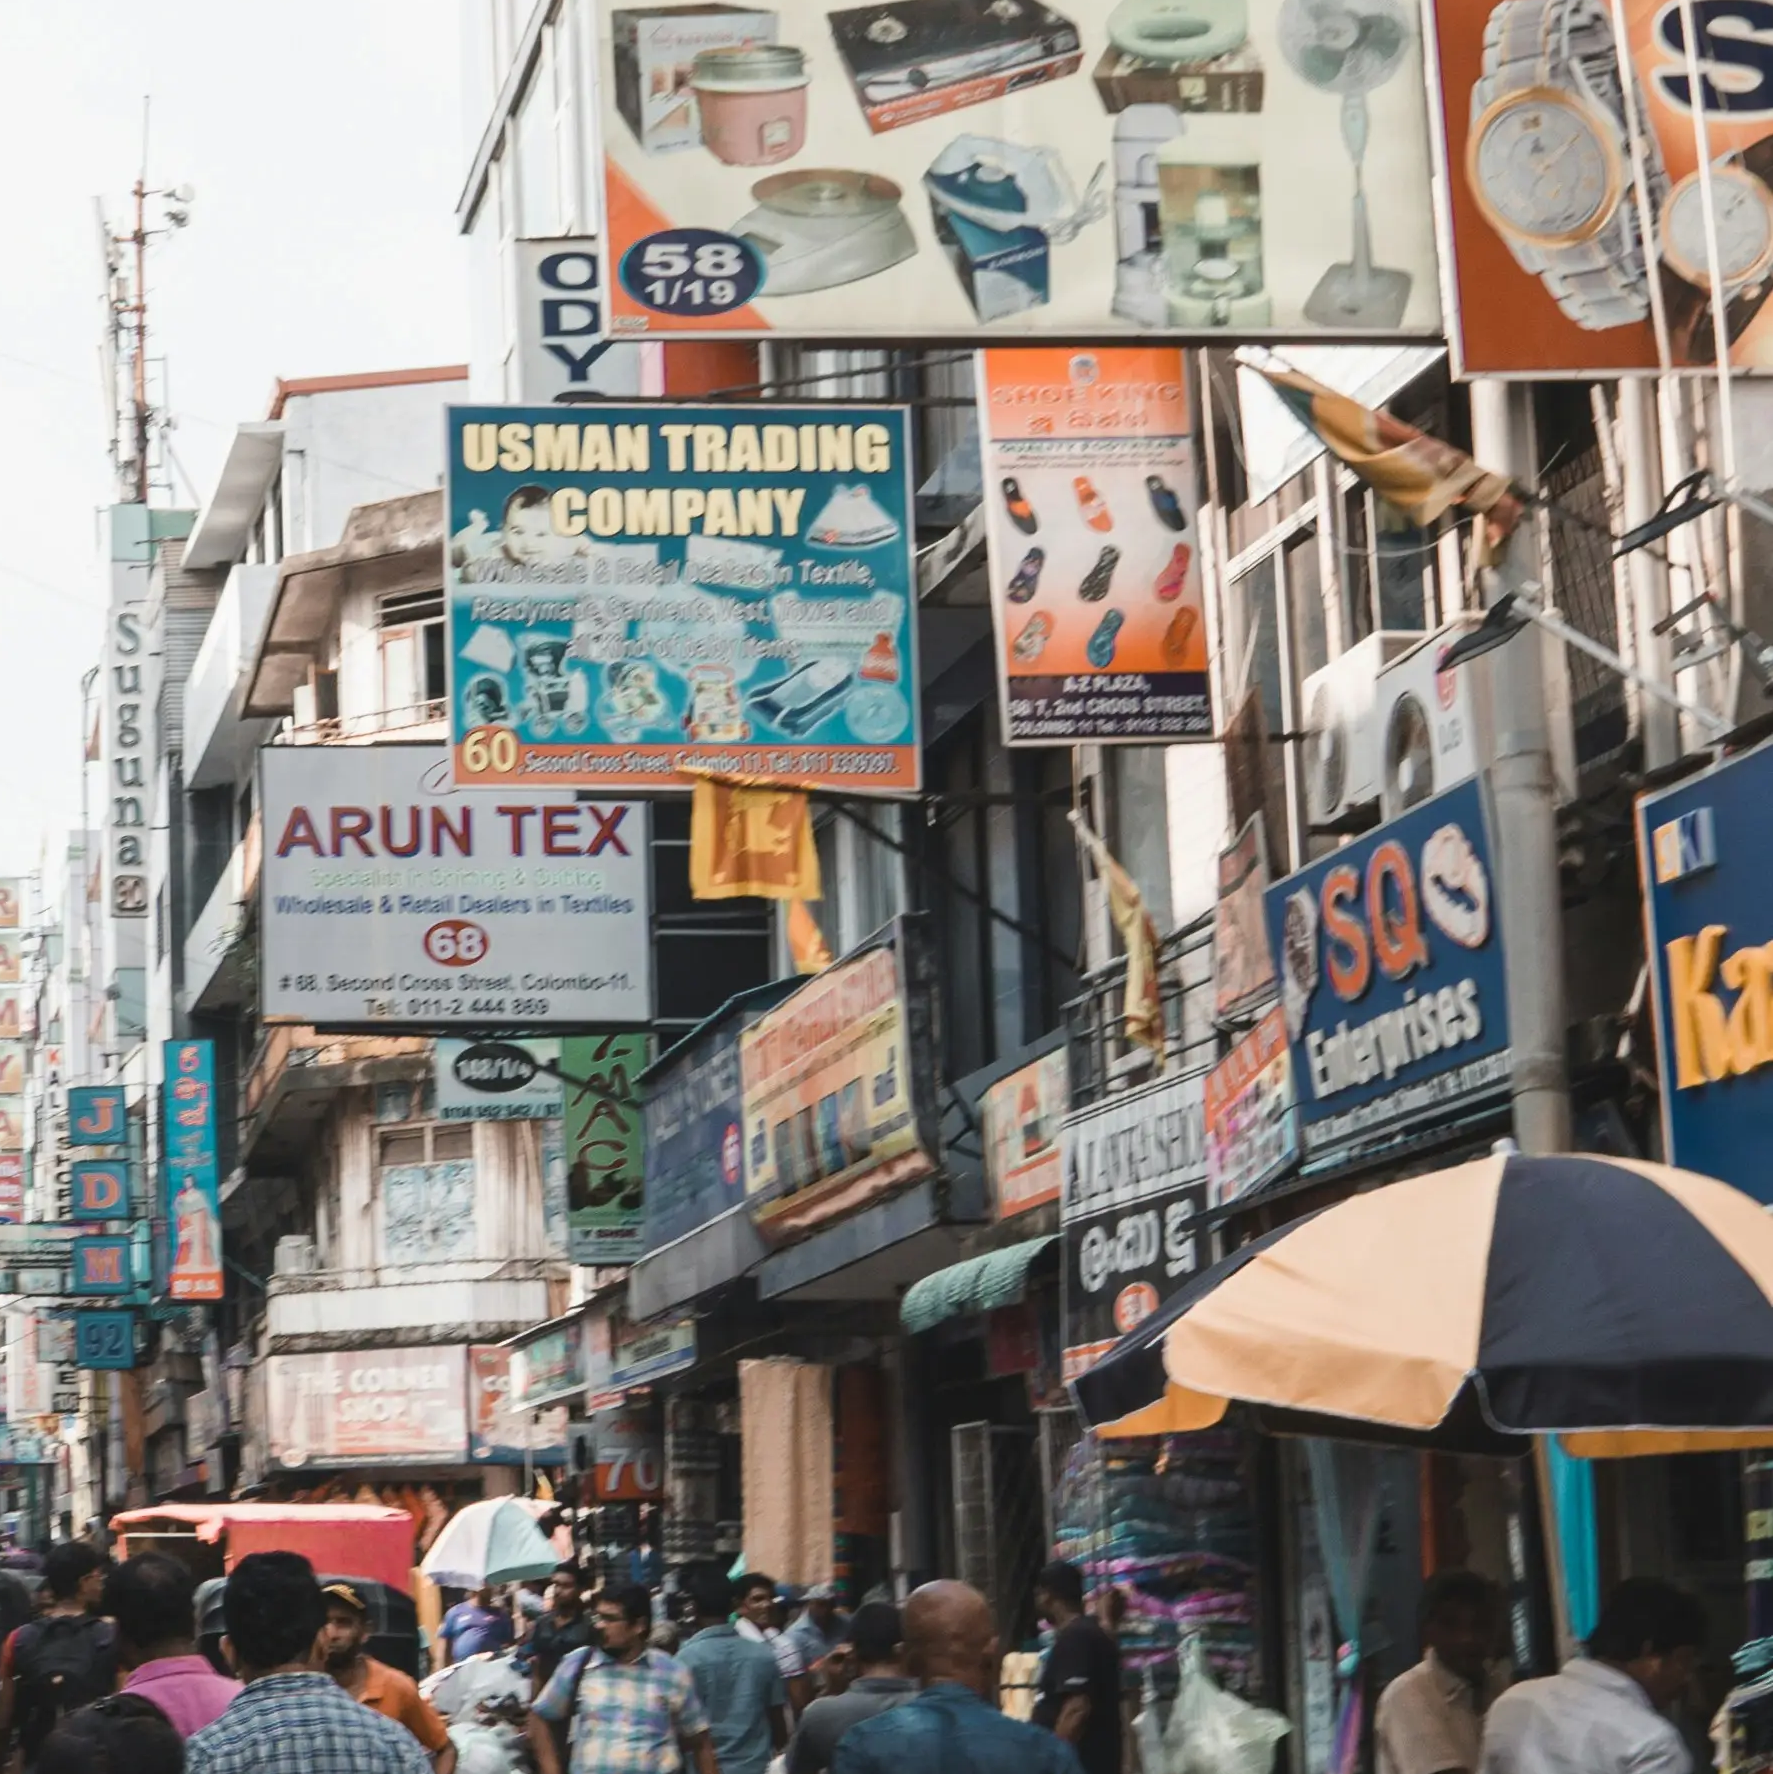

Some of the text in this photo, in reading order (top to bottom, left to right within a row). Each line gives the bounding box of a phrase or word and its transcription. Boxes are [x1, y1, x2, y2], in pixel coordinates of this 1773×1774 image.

[641, 242, 745, 278] 58
[644, 279, 738, 306] 1/19
[462, 422, 891, 474] USMAN TRADING
[551, 486, 807, 537] COMPANY
[111, 612, 145, 868] Suguna
[274, 804, 633, 859] ARUN TEX
[273, 893, 374, 915] Wholesale
[398, 893, 455, 915] Retail
[457, 893, 532, 915] Dealers
[559, 893, 635, 915] Textiles
[1320, 838, 1428, 1003] SQ
[428, 926, 486, 962] 68
[326, 972, 397, 993] Second
[399, 972, 455, 993] Cross
[1305, 977, 1482, 1102] Enterprises
[84, 1321, 126, 1361] 92
